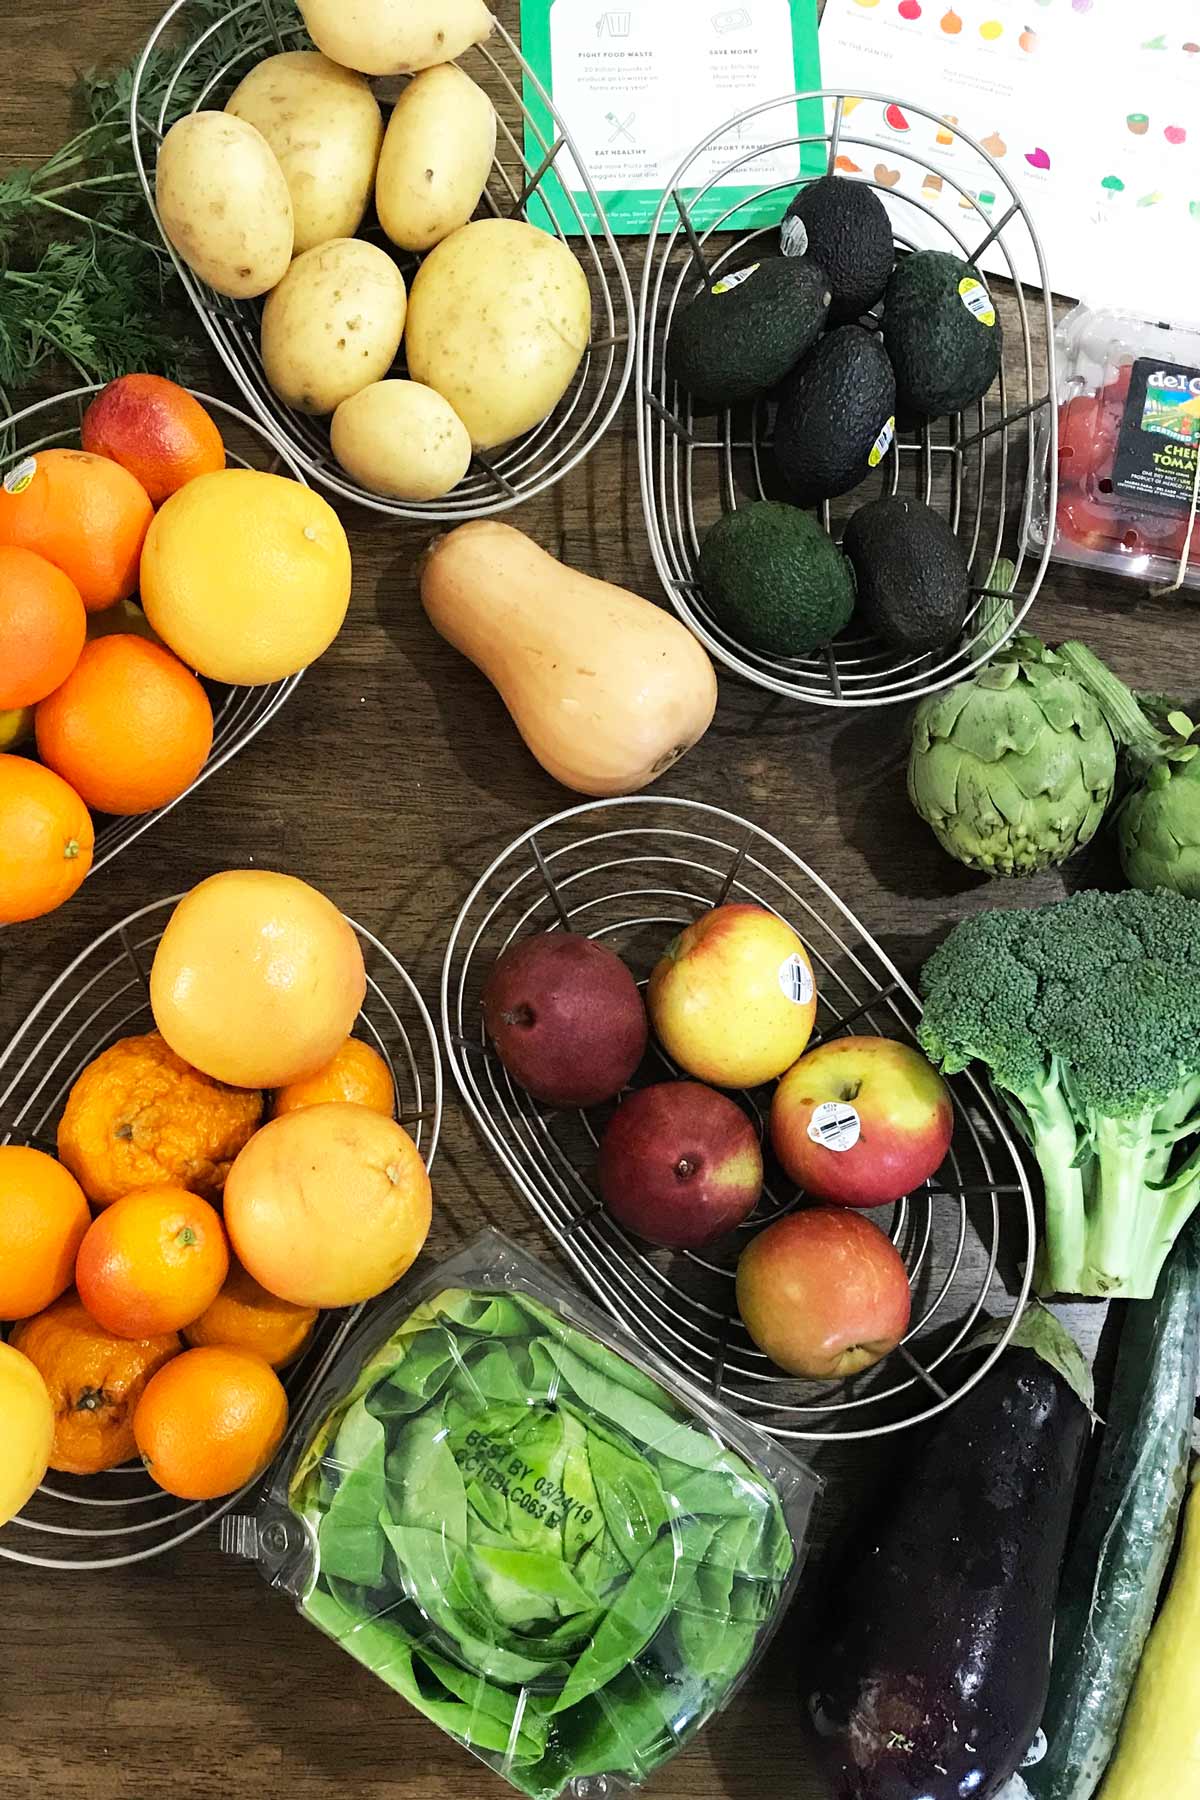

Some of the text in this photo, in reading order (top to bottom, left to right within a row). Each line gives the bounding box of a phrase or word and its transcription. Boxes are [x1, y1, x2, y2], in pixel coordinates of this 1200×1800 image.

[1150, 425, 1192, 442] CERTIFIED
[1131, 473, 1154, 483] PRODUCT
[466, 1429, 593, 1525] BEST BY 03/24/19
